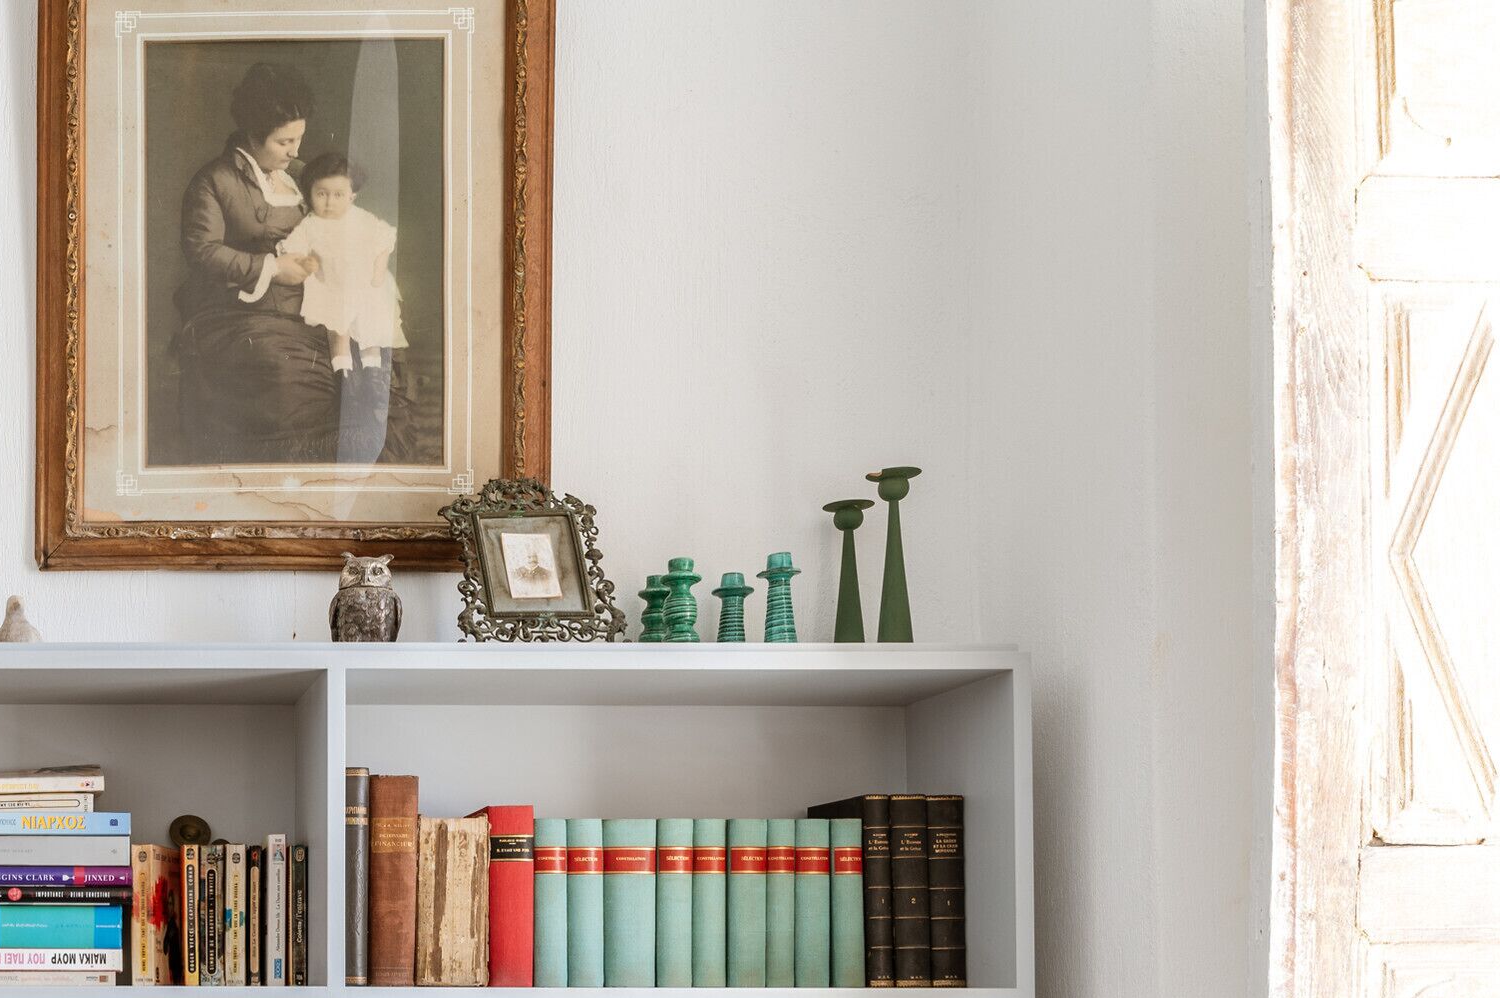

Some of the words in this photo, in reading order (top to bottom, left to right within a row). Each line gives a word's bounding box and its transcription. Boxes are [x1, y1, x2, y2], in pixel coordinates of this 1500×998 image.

[20, 815, 87, 831] ΝΙΑΡΧΟΣ
[25, 873, 56, 881] CLARK
[83, 873, 115, 882] JINXED
[187, 927, 195, 949] VERCEL
[3, 952, 24, 965] ΠΑΕΙ
[26, 953, 46, 965] ΠΟΥ
[50, 952, 77, 965] ΜΟΥΡ
[78, 952, 107, 969] ΜΑΪΚΛ
